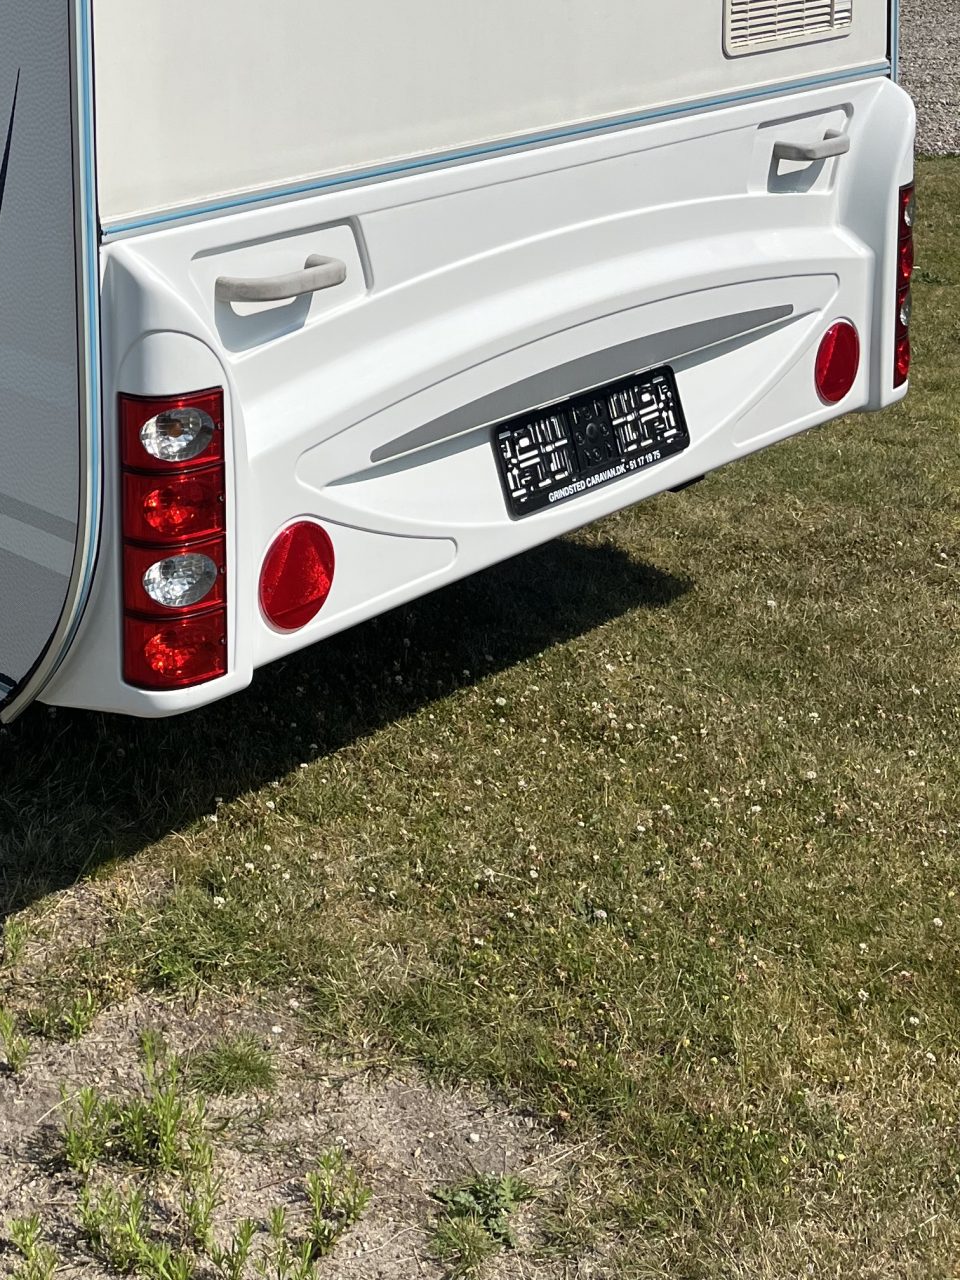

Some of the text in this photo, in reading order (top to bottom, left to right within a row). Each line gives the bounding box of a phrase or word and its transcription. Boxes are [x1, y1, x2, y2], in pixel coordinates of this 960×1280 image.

[548, 449, 661, 503] GRINDSTED CARAVAN.DK 51 17 19 75
